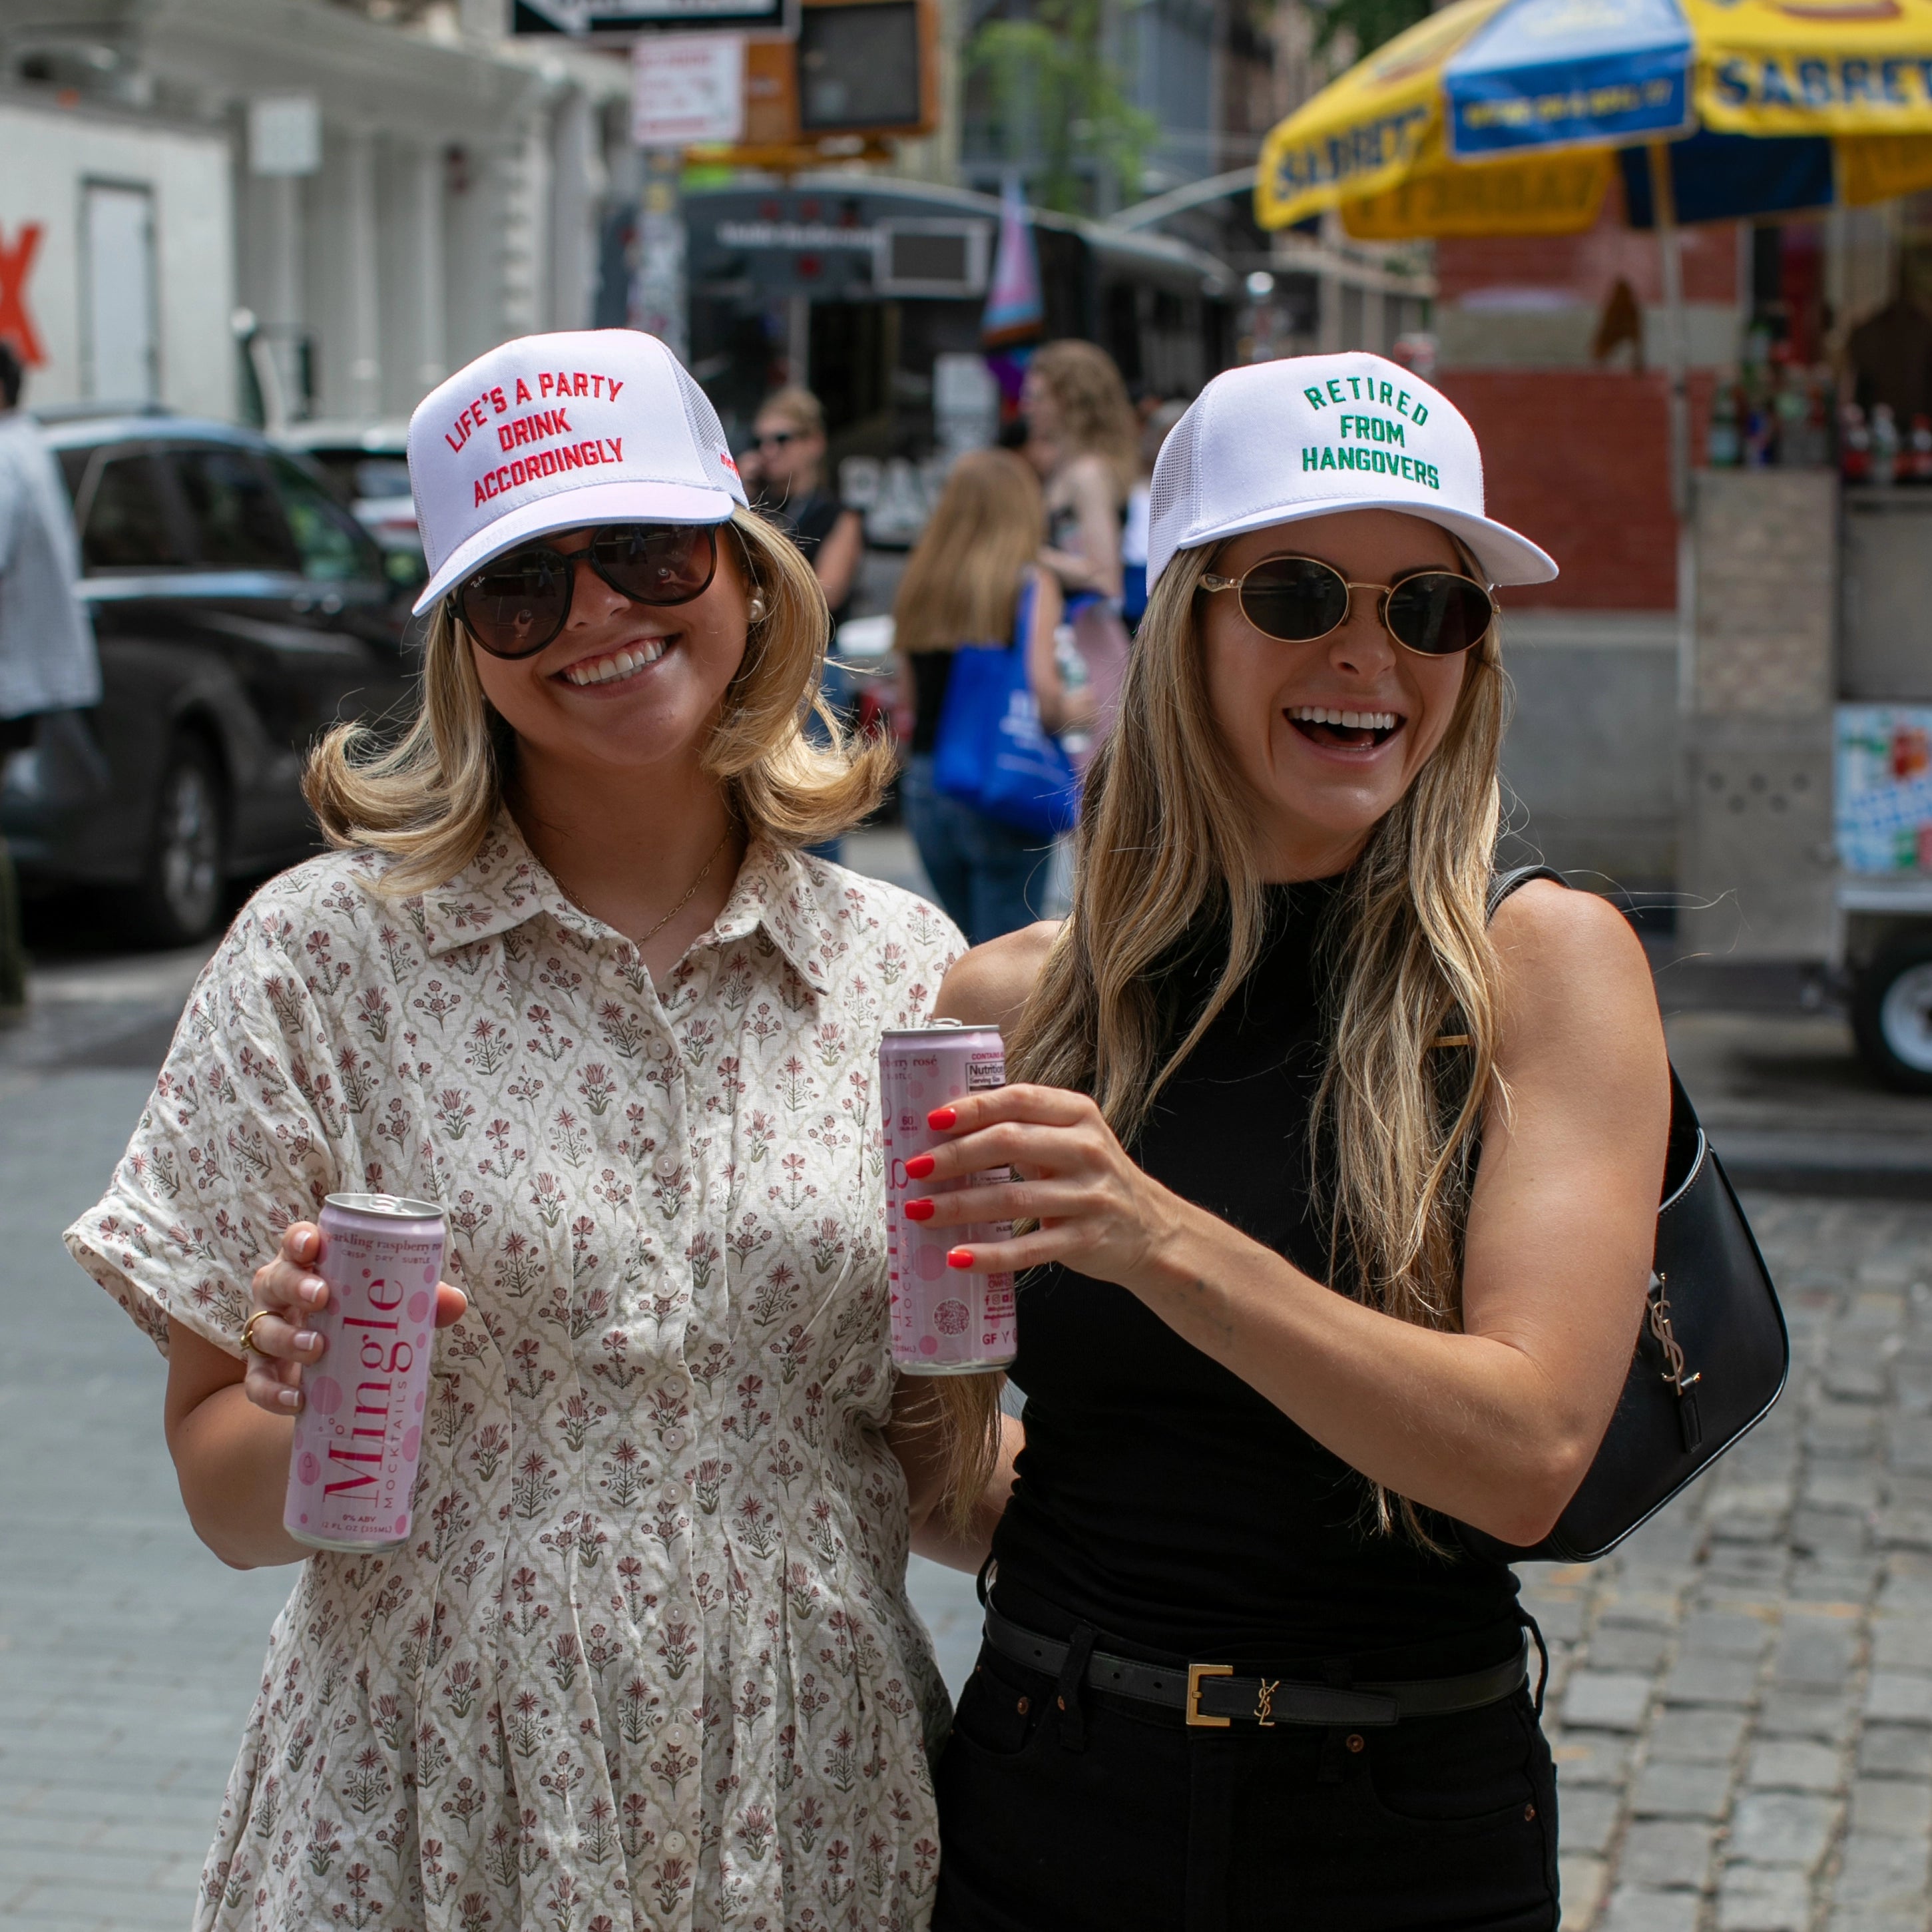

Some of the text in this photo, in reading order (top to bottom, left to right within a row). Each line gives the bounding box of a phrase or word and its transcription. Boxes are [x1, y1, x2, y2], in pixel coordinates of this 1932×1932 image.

[445, 371, 623, 453] LIFE'S A PARTY
[1304, 377, 1429, 426] RETIRED
[497, 407, 573, 452] DRINK
[1340, 415, 1405, 448] FROM
[473, 437, 623, 508] ACCORDINGLY
[1302, 447, 1440, 489] HANGOVERS
[913, 1054, 937, 1067] rosé
[901, 1116, 913, 1125] 60
[342, 1249, 366, 1259] CRISP
[377, 1240, 429, 1254] raspberry
[982, 1333, 997, 1345] GF
[323, 1278, 413, 1508] Mingle
[383, 1380, 407, 1509] MOCKTAILS
